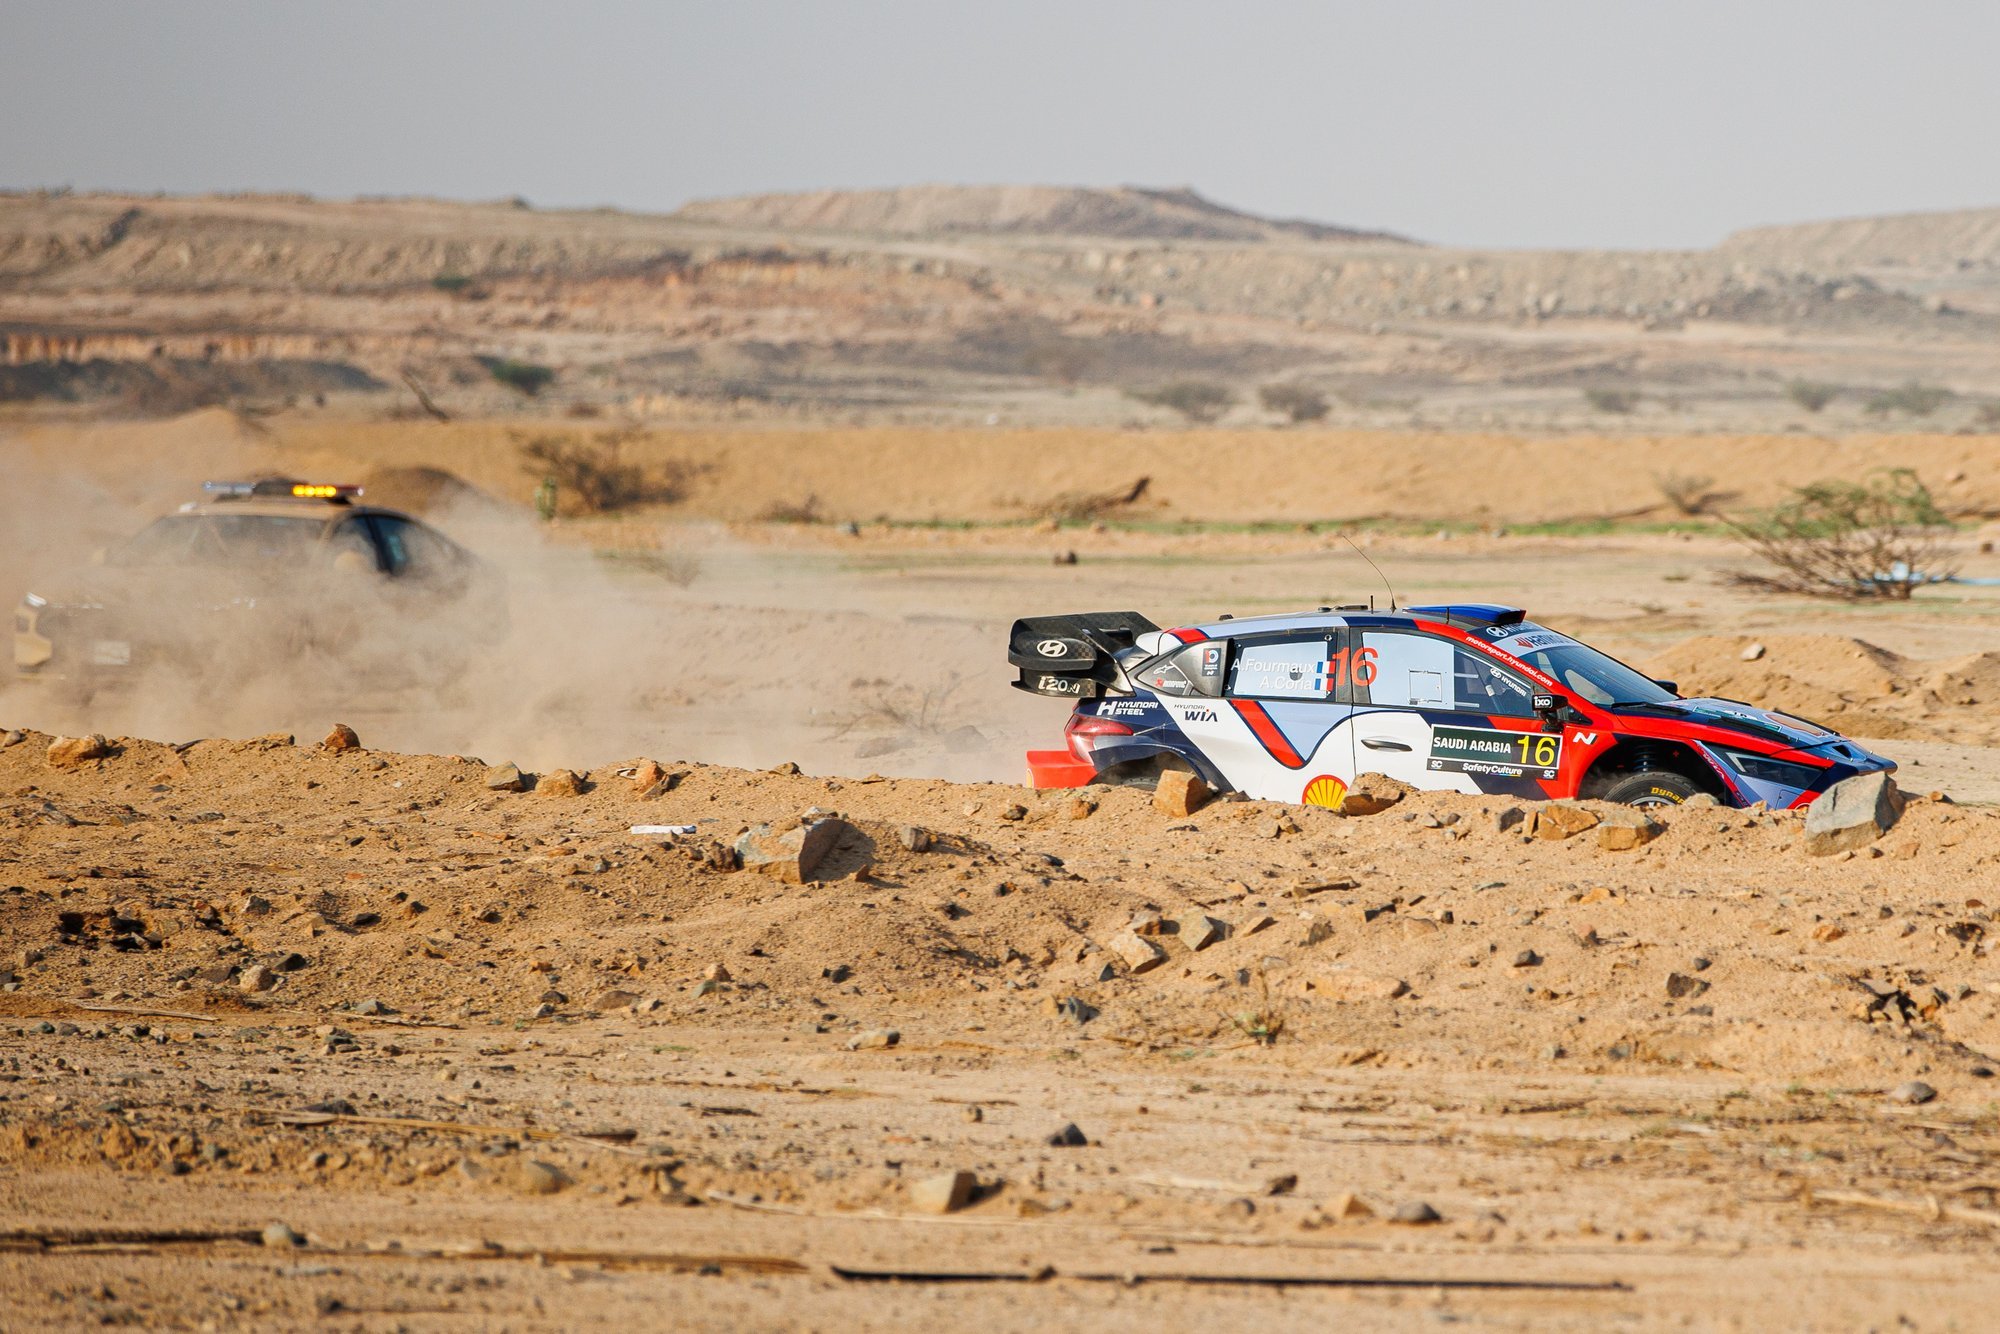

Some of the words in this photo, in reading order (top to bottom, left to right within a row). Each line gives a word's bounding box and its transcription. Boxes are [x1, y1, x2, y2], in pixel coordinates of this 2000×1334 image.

[1332, 646, 1379, 687] 16
[1466, 636, 1553, 687] motorsport.hyundai.com
[1501, 675, 1527, 697] HYUNDAI
[1115, 708, 1145, 716] STEEL
[1433, 736, 1467, 750] SAUDI
[1469, 739, 1511, 754] ARABIA
[1517, 735, 1556, 767] 16
[1462, 762, 1523, 775] SafetyCulture
